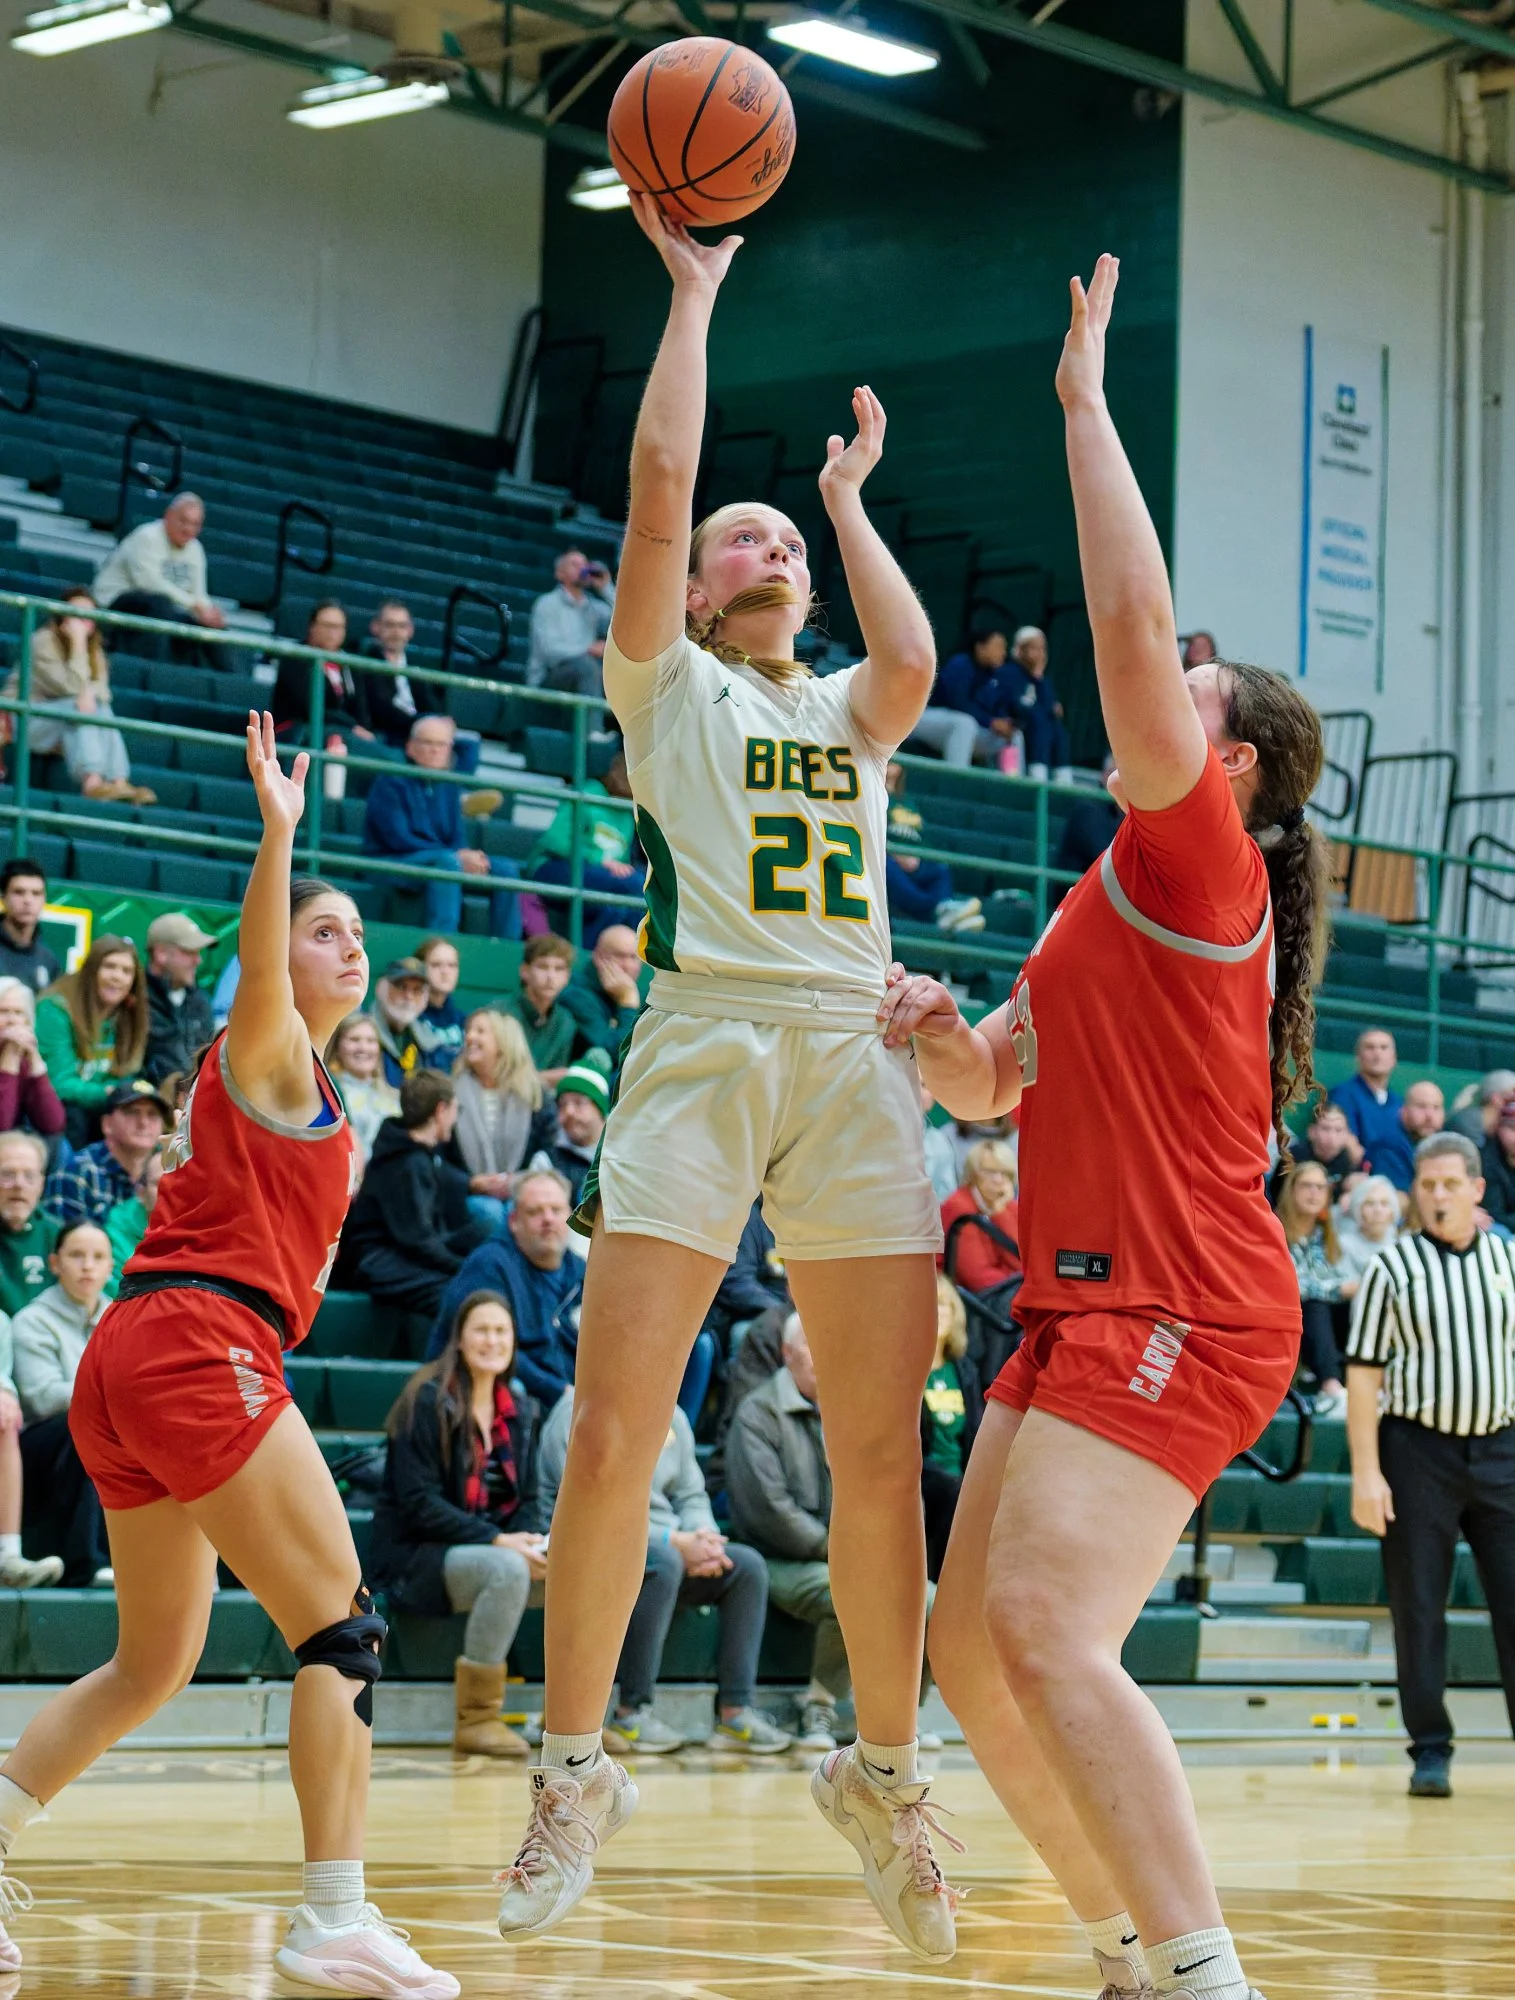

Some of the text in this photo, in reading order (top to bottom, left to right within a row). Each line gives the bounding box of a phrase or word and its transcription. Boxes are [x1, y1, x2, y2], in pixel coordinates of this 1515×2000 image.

[744, 735, 862, 803] BEES
[748, 812, 871, 925] 22
[1092, 1260, 1103, 1272] XL
